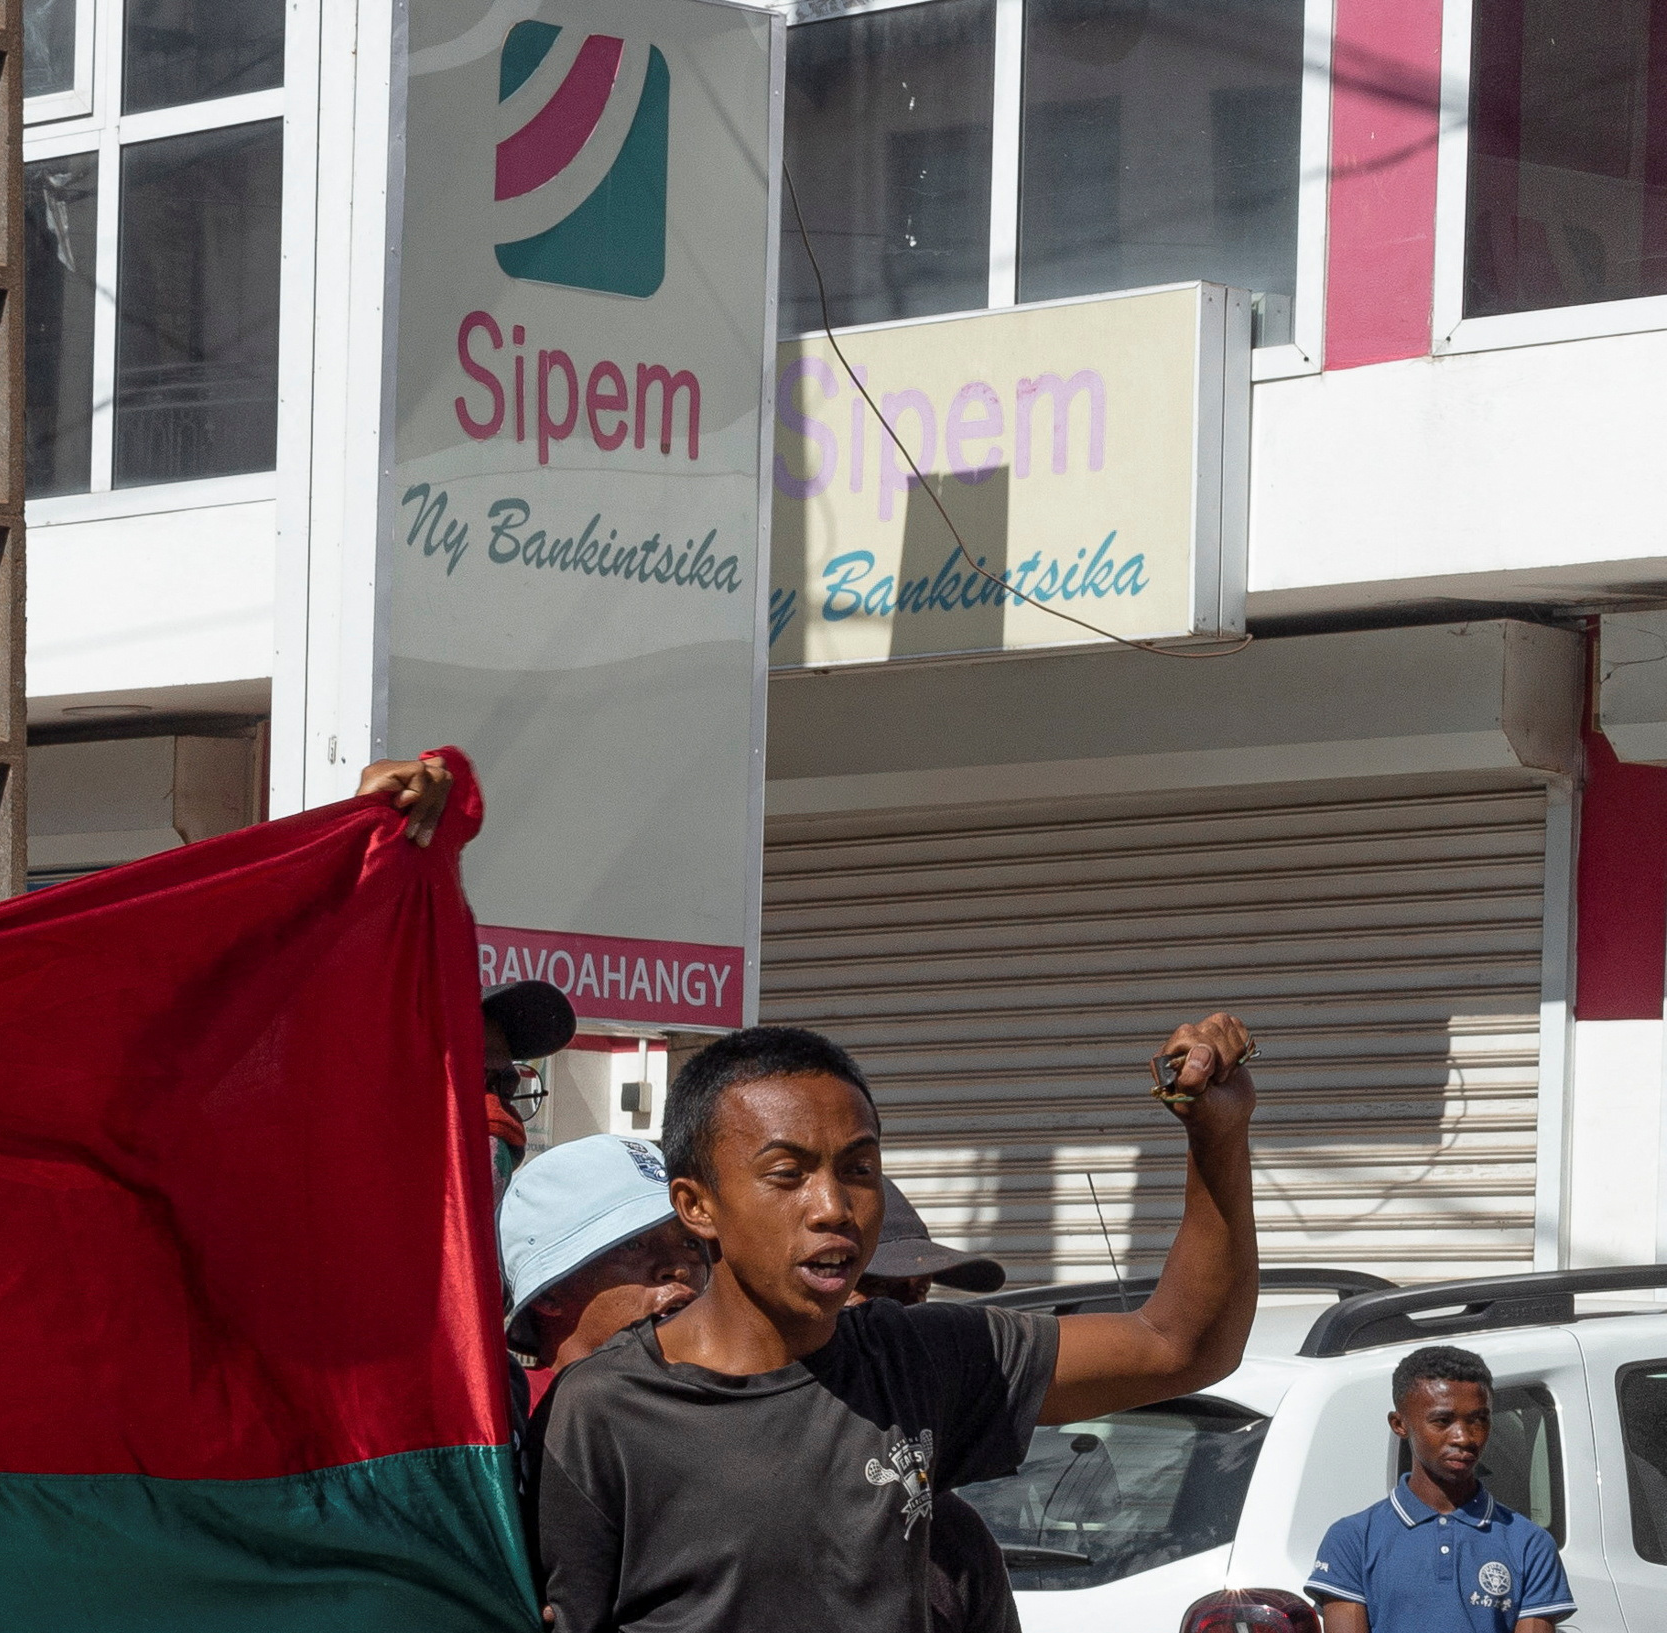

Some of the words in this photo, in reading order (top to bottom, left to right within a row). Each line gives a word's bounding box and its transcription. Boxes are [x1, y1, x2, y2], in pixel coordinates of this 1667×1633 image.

[455, 310, 701, 466] Sipem
[773, 356, 1107, 523] Sipem
[401, 482, 469, 577] Ny
[487, 497, 742, 593] Bankintsika
[769, 587, 797, 649] y
[821, 529, 1150, 622] Bankintsika
